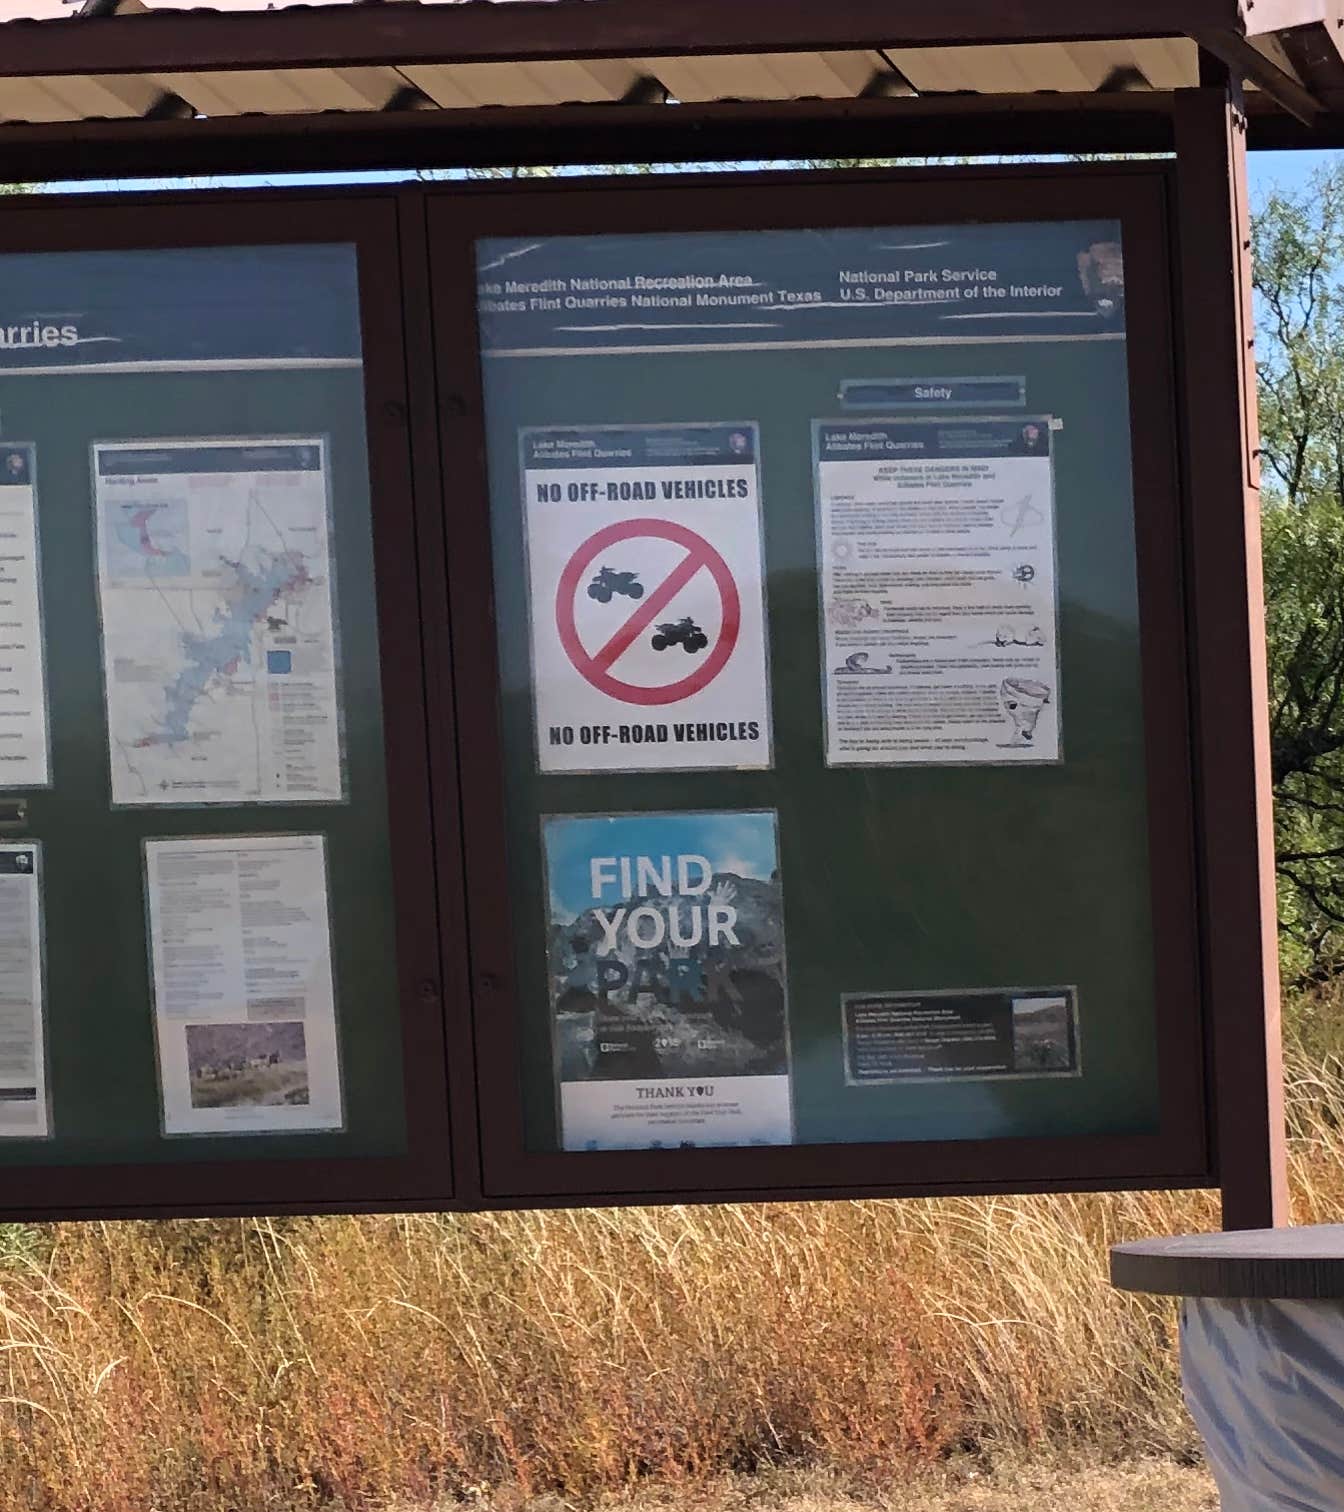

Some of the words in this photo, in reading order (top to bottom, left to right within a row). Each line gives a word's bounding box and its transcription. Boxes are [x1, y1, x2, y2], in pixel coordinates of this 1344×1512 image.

[505, 280, 566, 293] Meredith
[570, 278, 632, 291] National
[634, 274, 713, 291] Recreation
[718, 274, 752, 288] Area
[840, 270, 900, 283] National
[904, 270, 938, 283] Park
[942, 269, 997, 282] Service
[530, 298, 561, 310] Flint
[565, 295, 627, 309] Quarries
[631, 293, 692, 308] National
[696, 291, 774, 306] Monument
[777, 290, 822, 302] Texas
[840, 287, 870, 300] U.S.
[874, 287, 960, 302] Department
[964, 287, 978, 298] of
[983, 286, 1006, 298] the
[1010, 285, 1063, 297] Interior
[914, 386, 952, 400] Safety
[537, 483, 562, 503] NO
[567, 481, 656, 502] OFF-ROAD
[661, 478, 749, 500] VEHICLES
[549, 726, 574, 745] NO
[580, 724, 668, 745] OFF-ROAD
[673, 721, 760, 742] VEHICLES
[590, 854, 713, 898] FIND
[592, 905, 741, 953] YOUR
[636, 1087, 685, 1099] THANK
